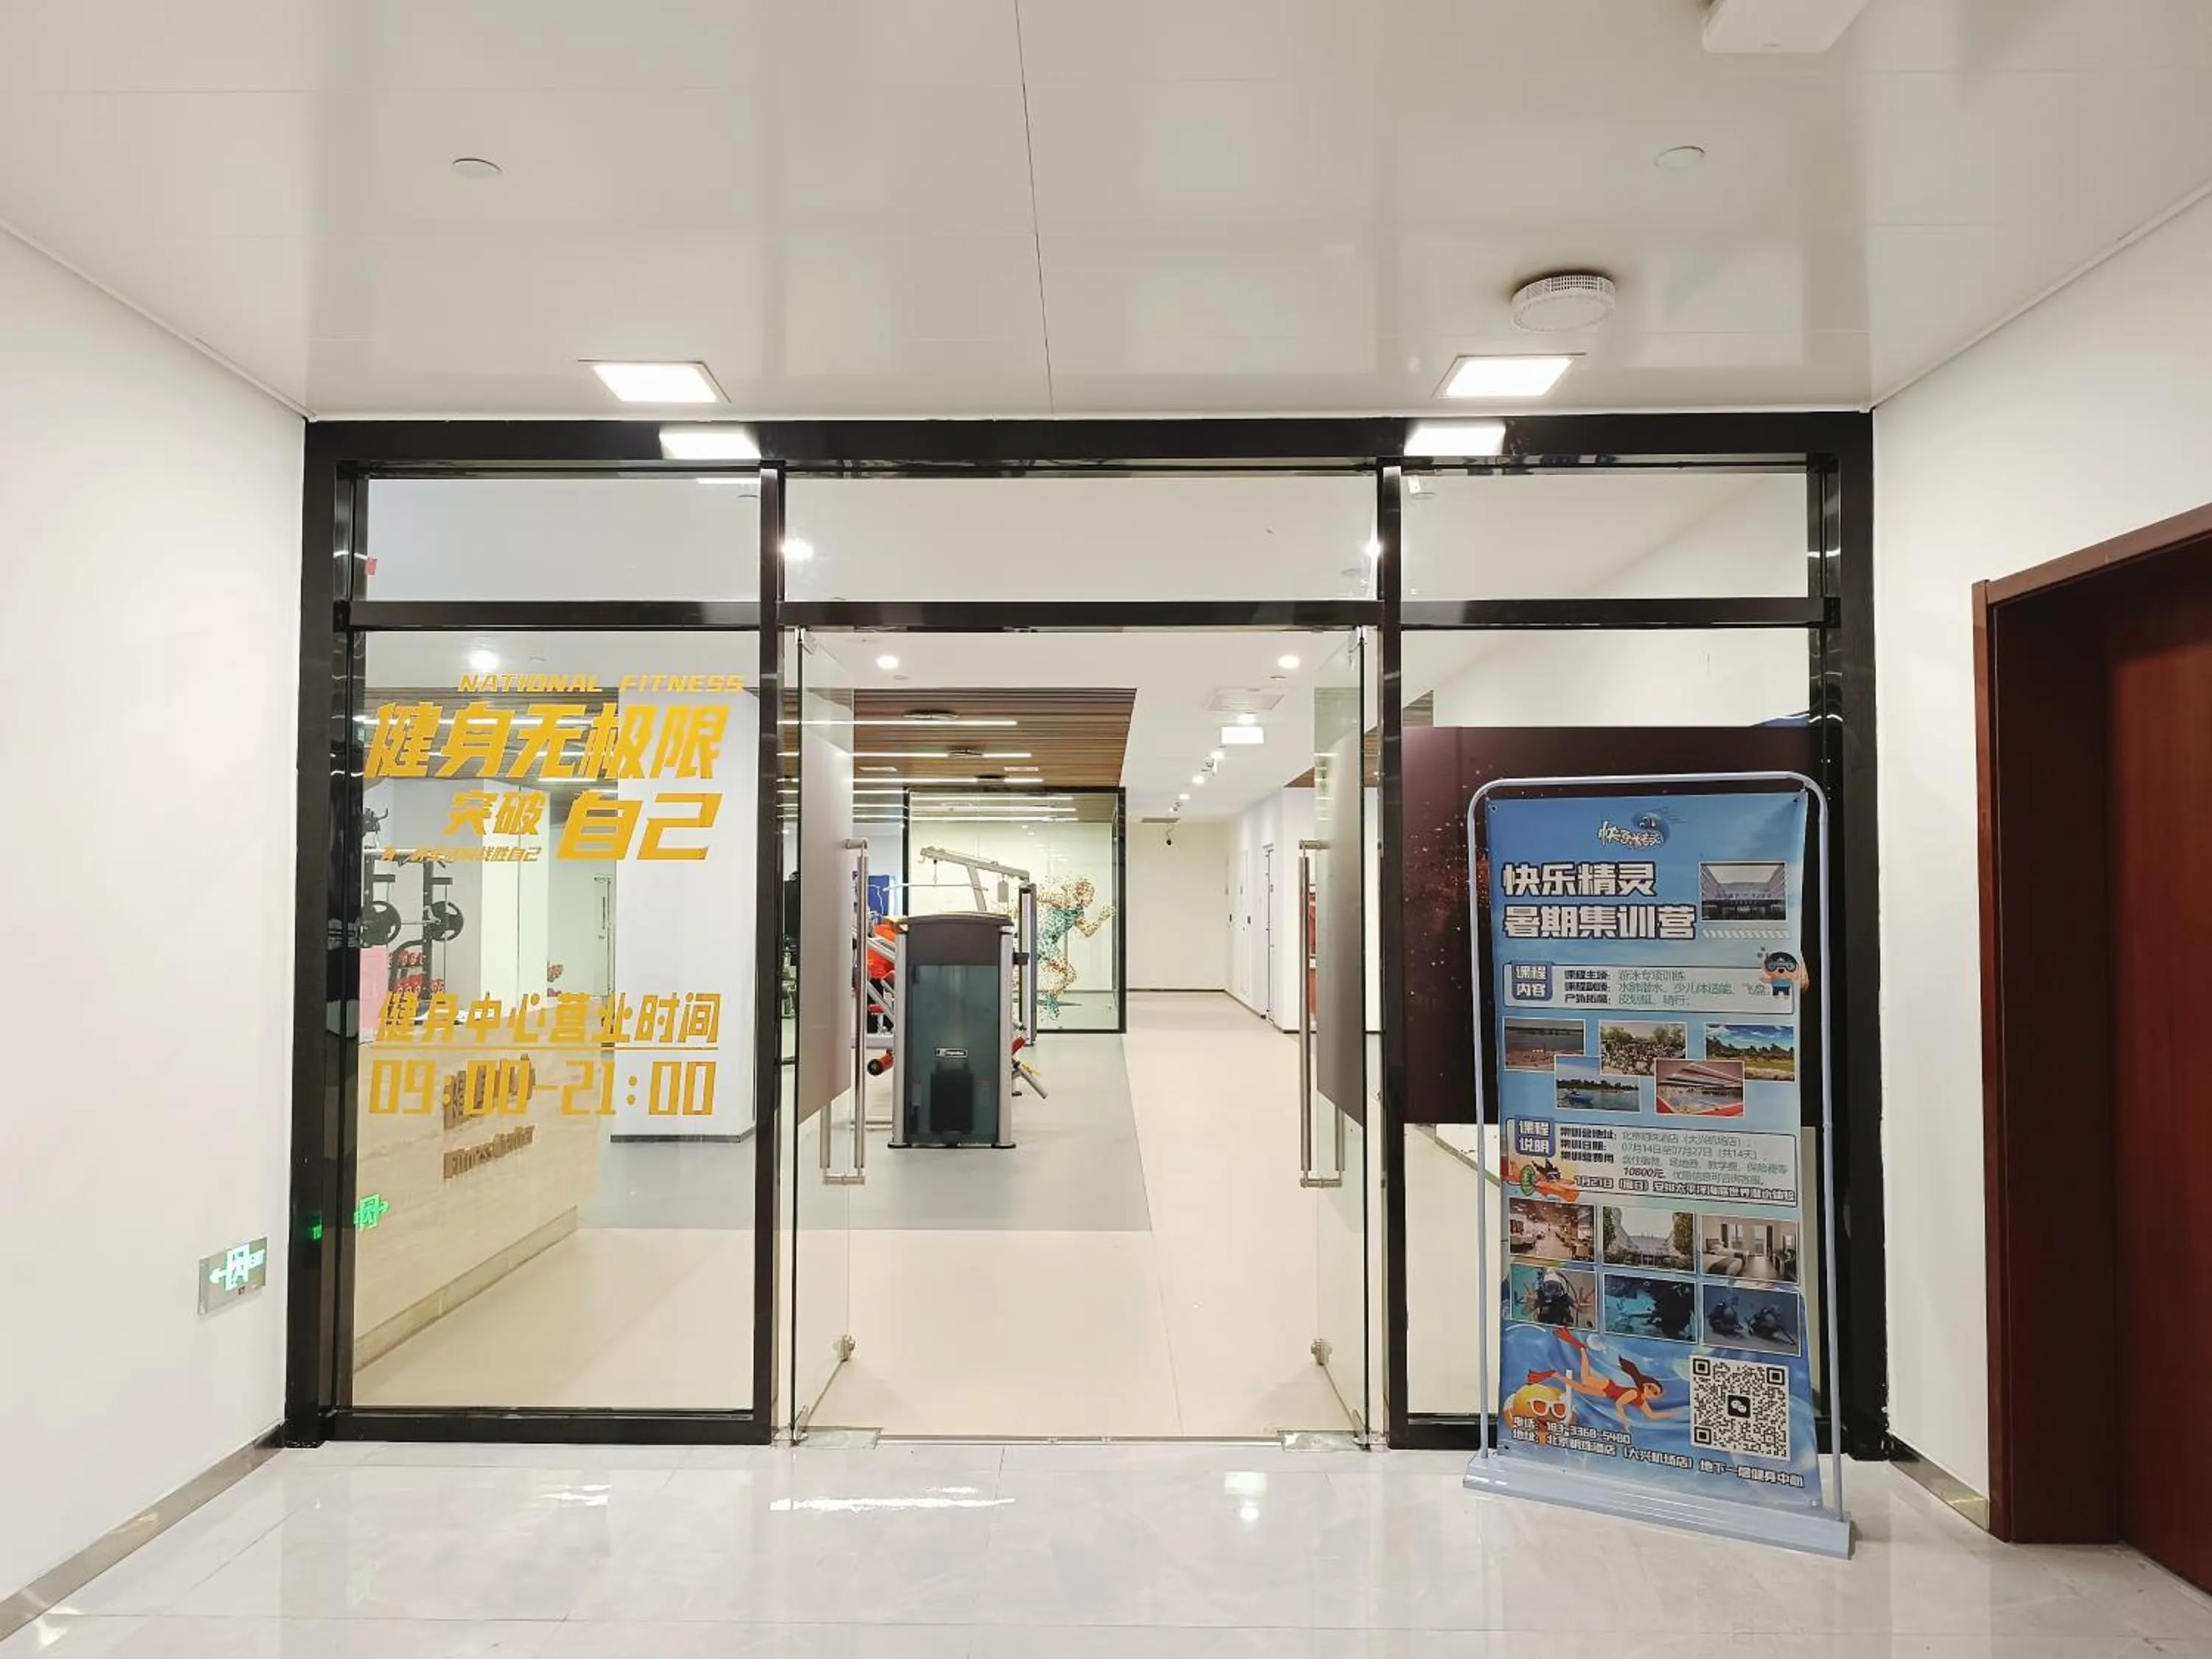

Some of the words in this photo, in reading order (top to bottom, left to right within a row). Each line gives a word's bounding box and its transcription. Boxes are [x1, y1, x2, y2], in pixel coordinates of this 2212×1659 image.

[457, 673, 602, 692] NATIONAL
[618, 675, 745, 693] FITNESS
[365, 701, 731, 779] 健身无极限
[445, 790, 549, 836] 突破
[557, 790, 723, 860] 自己
[1502, 861, 1657, 897] 快乐精灵
[1503, 904, 1697, 939] 暑期集训营
[1516, 966, 1546, 981] 课程
[1516, 983, 1546, 997] 内容
[377, 992, 721, 1043] 健身中心营业时间
[368, 1059, 717, 1116] 09:00-21:00
[1518, 1120, 1550, 1136] 课程
[1519, 1138, 1550, 1154] 说明
